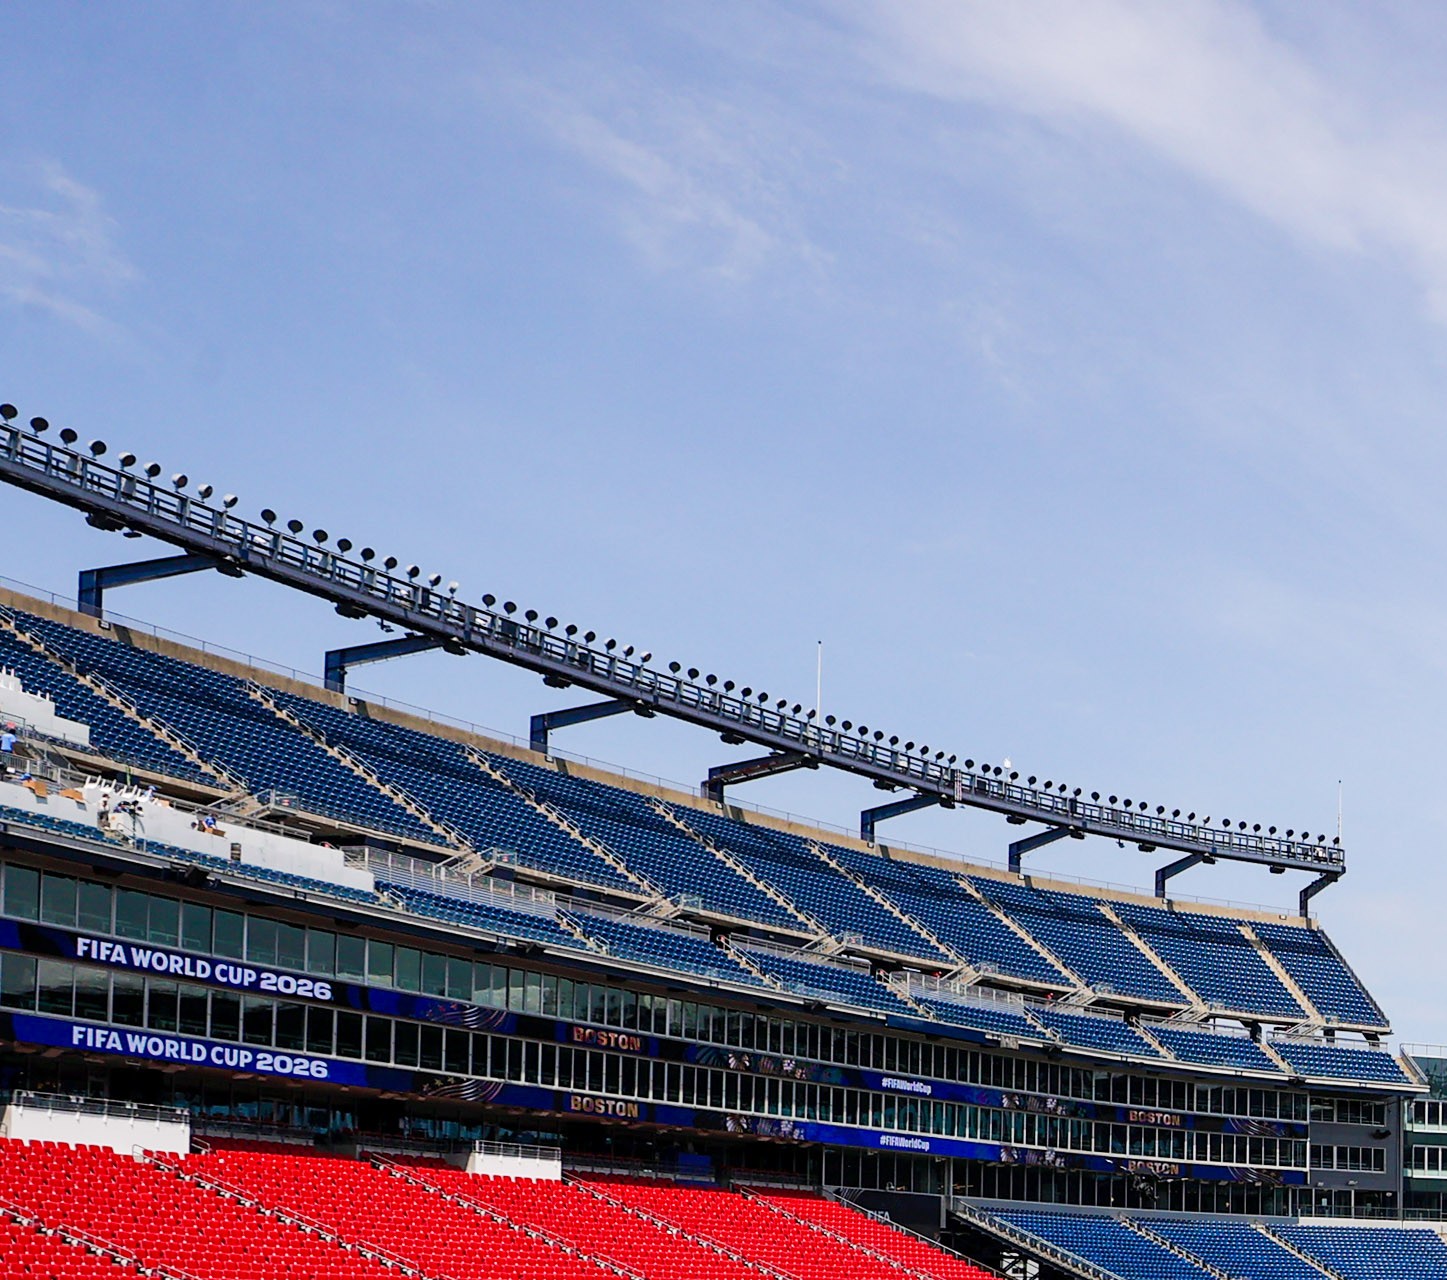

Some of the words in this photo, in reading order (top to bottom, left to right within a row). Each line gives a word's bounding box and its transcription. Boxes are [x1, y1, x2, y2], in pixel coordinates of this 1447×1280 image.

[77, 937, 128, 965] FIFA
[131, 946, 211, 979] WORLD
[215, 963, 257, 987] CUP
[260, 972, 332, 1000] 2026
[573, 1026, 641, 1051] BOSTON
[73, 1025, 123, 1051] FIFA
[125, 1033, 207, 1062] WORLD
[211, 1045, 253, 1068] CUP
[256, 1052, 329, 1079] 2026
[881, 1077, 932, 1096] #FIFAWorldCup
[570, 1095, 639, 1118] BOSTON
[1129, 1110, 1181, 1126] BOSTON
[879, 1134, 930, 1152] #FIFAWorldCup
